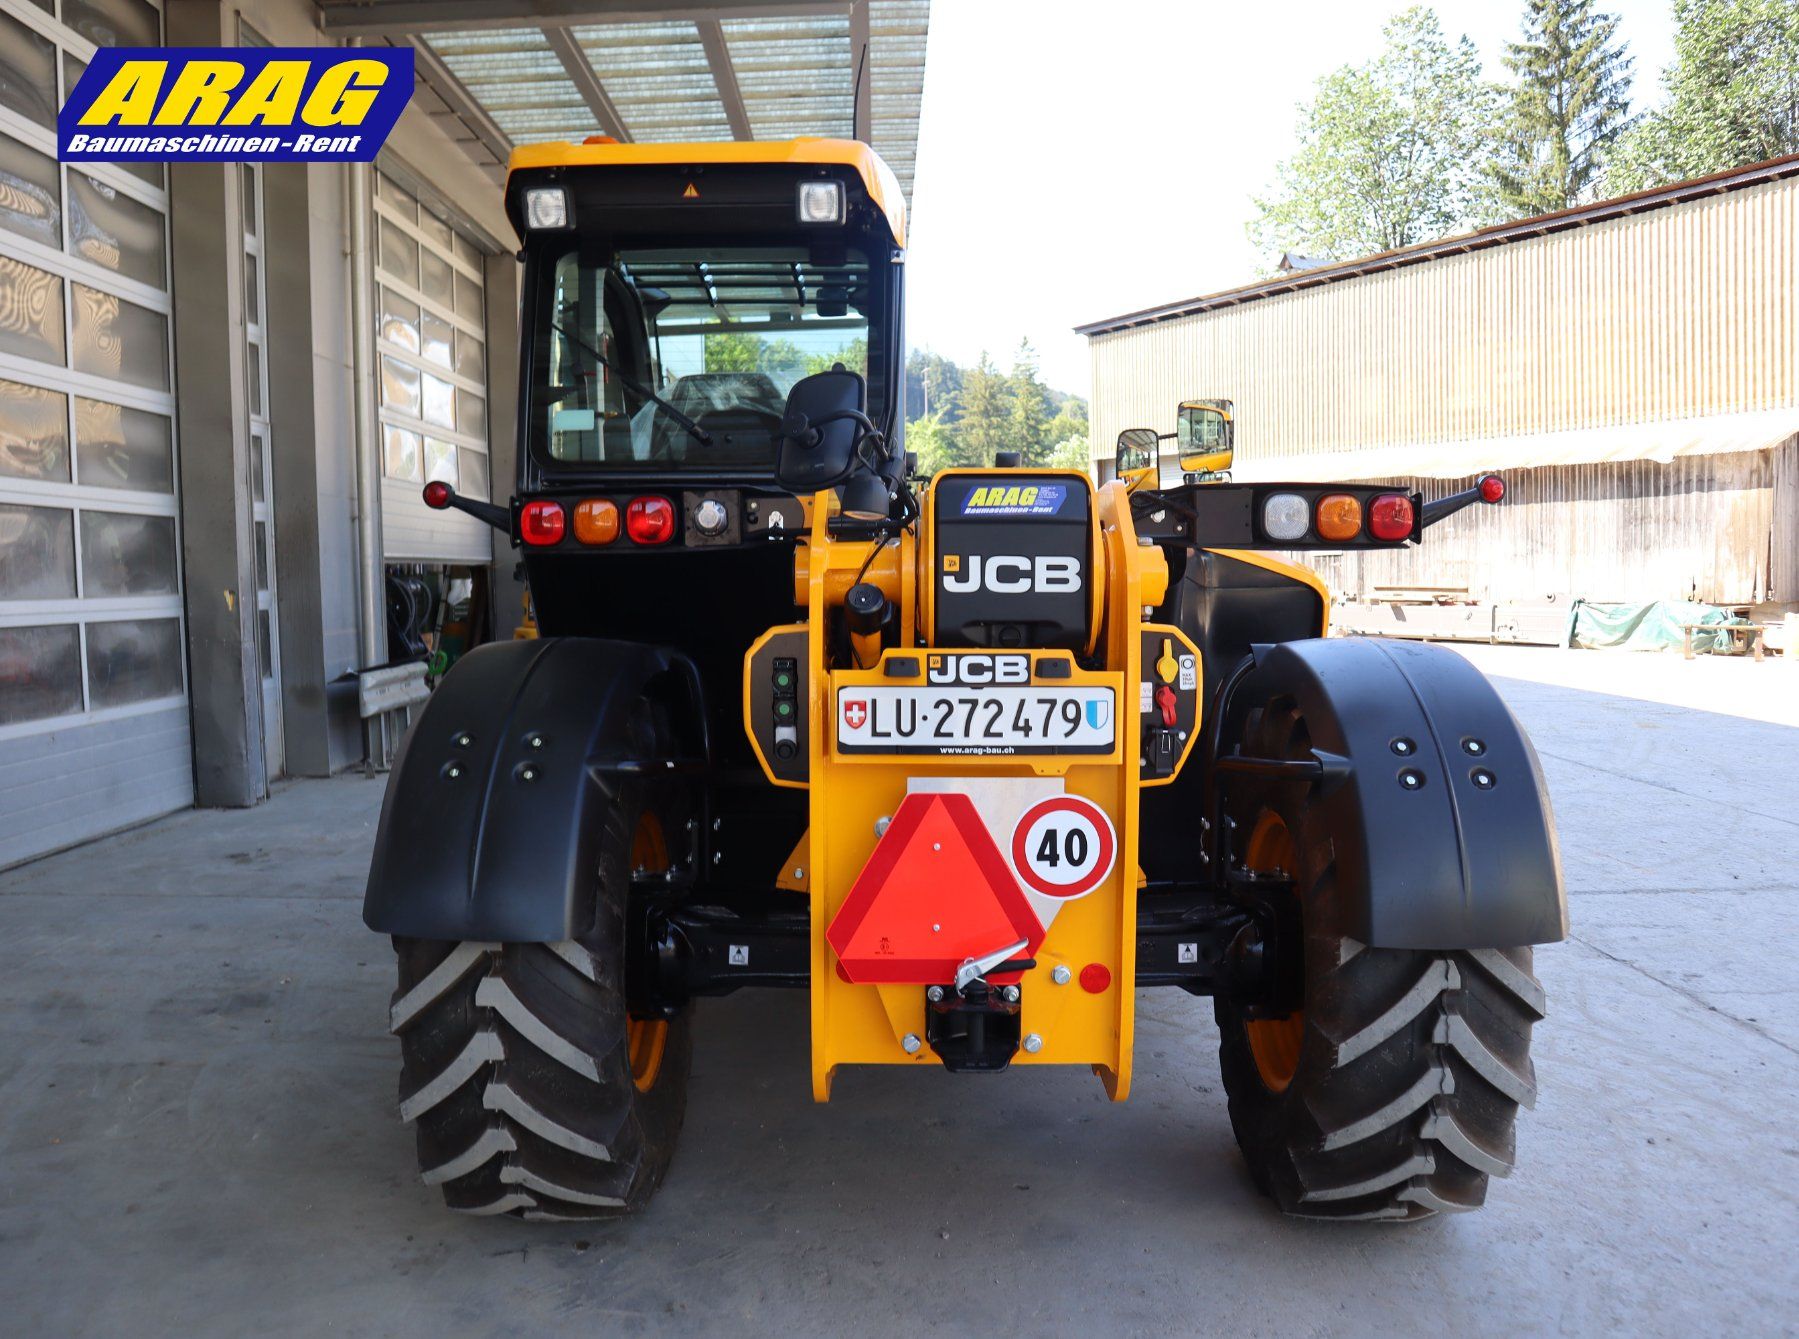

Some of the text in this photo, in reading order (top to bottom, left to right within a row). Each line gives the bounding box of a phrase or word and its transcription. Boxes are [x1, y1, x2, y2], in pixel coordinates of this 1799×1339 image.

[967, 486, 1039, 507] ARAG
[943, 555, 1082, 593] JCB
[929, 655, 1029, 683] JCB
[939, 746, 1015, 755] www.arag-bau.ch
[1036, 828, 1088, 867] 40
